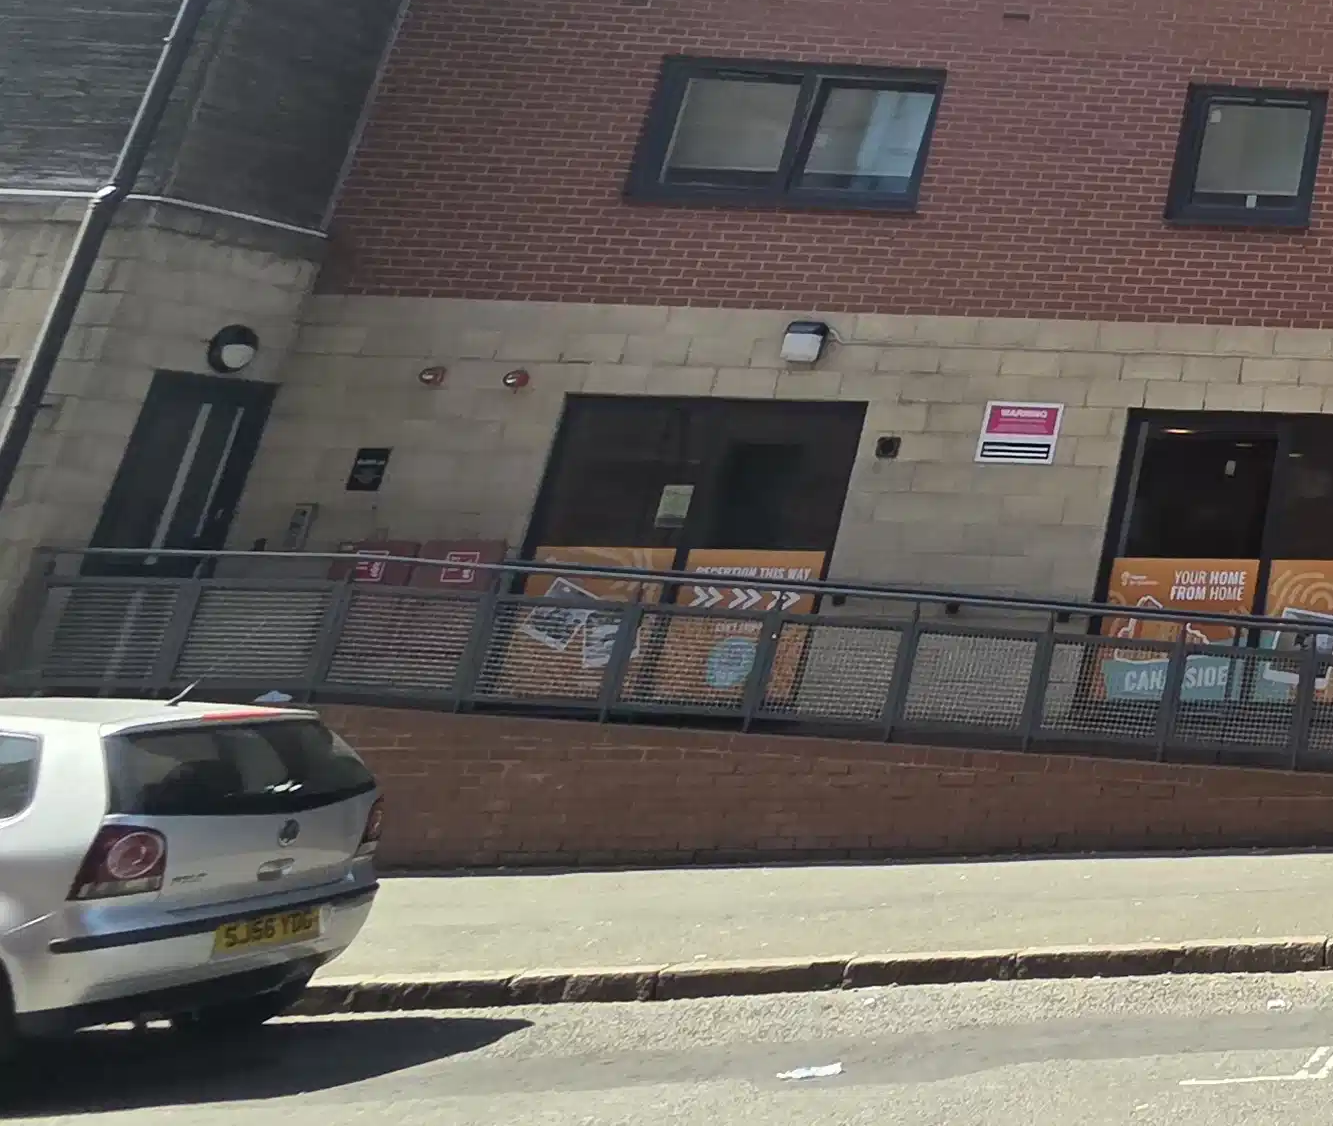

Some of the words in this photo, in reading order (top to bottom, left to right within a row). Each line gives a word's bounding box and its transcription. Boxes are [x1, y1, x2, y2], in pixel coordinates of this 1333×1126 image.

[759, 567, 785, 579] THIS
[788, 568, 812, 580] WAY
[1174, 570, 1206, 586] YOUR
[1209, 570, 1247, 586] HOME
[1170, 585, 1206, 601] FROM
[1209, 585, 1245, 601] HOME
[1124, 665, 1229, 692] CANSIDE
